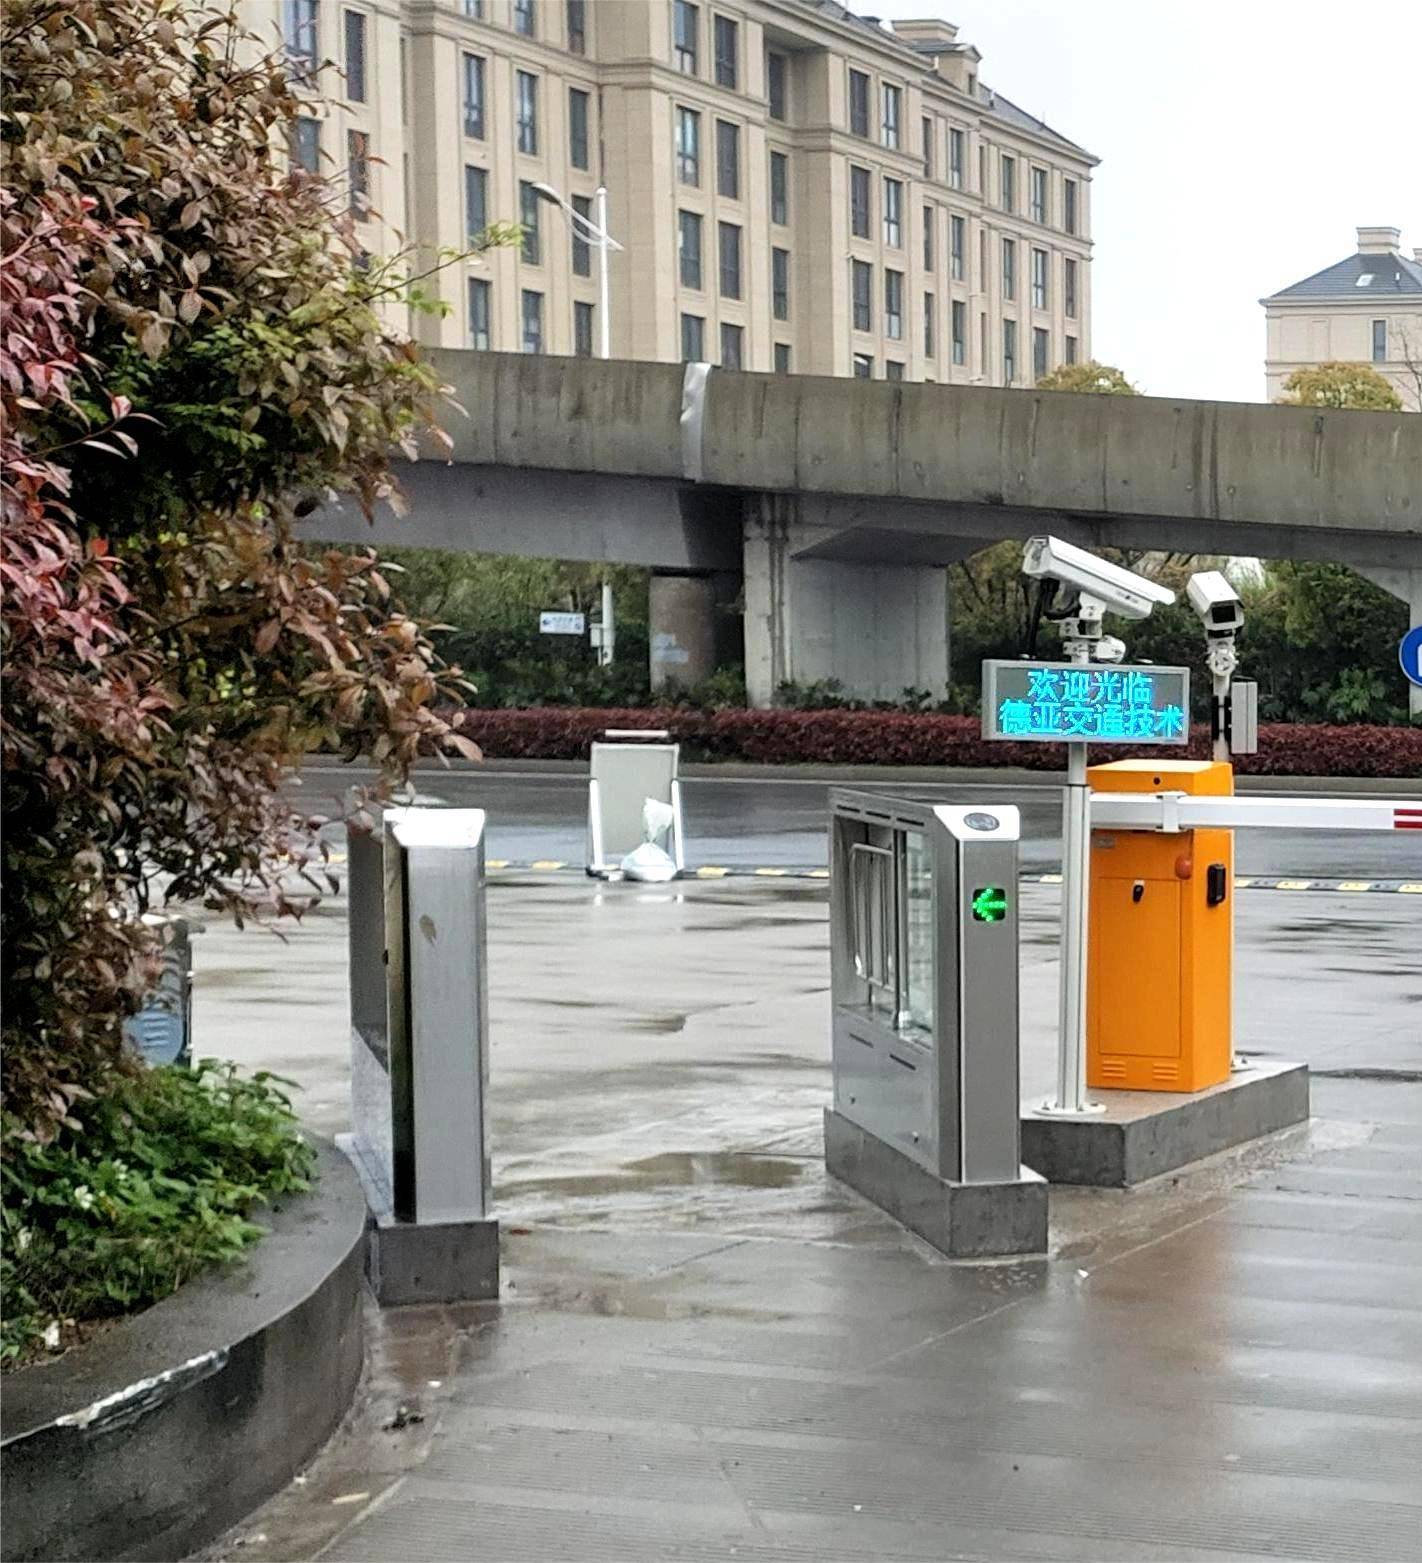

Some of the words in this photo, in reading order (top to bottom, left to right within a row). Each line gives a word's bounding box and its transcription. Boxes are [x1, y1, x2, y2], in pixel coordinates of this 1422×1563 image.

[1027, 668, 1153, 704] 欢迎光临
[999, 698, 1184, 738] 德亚交通技术
